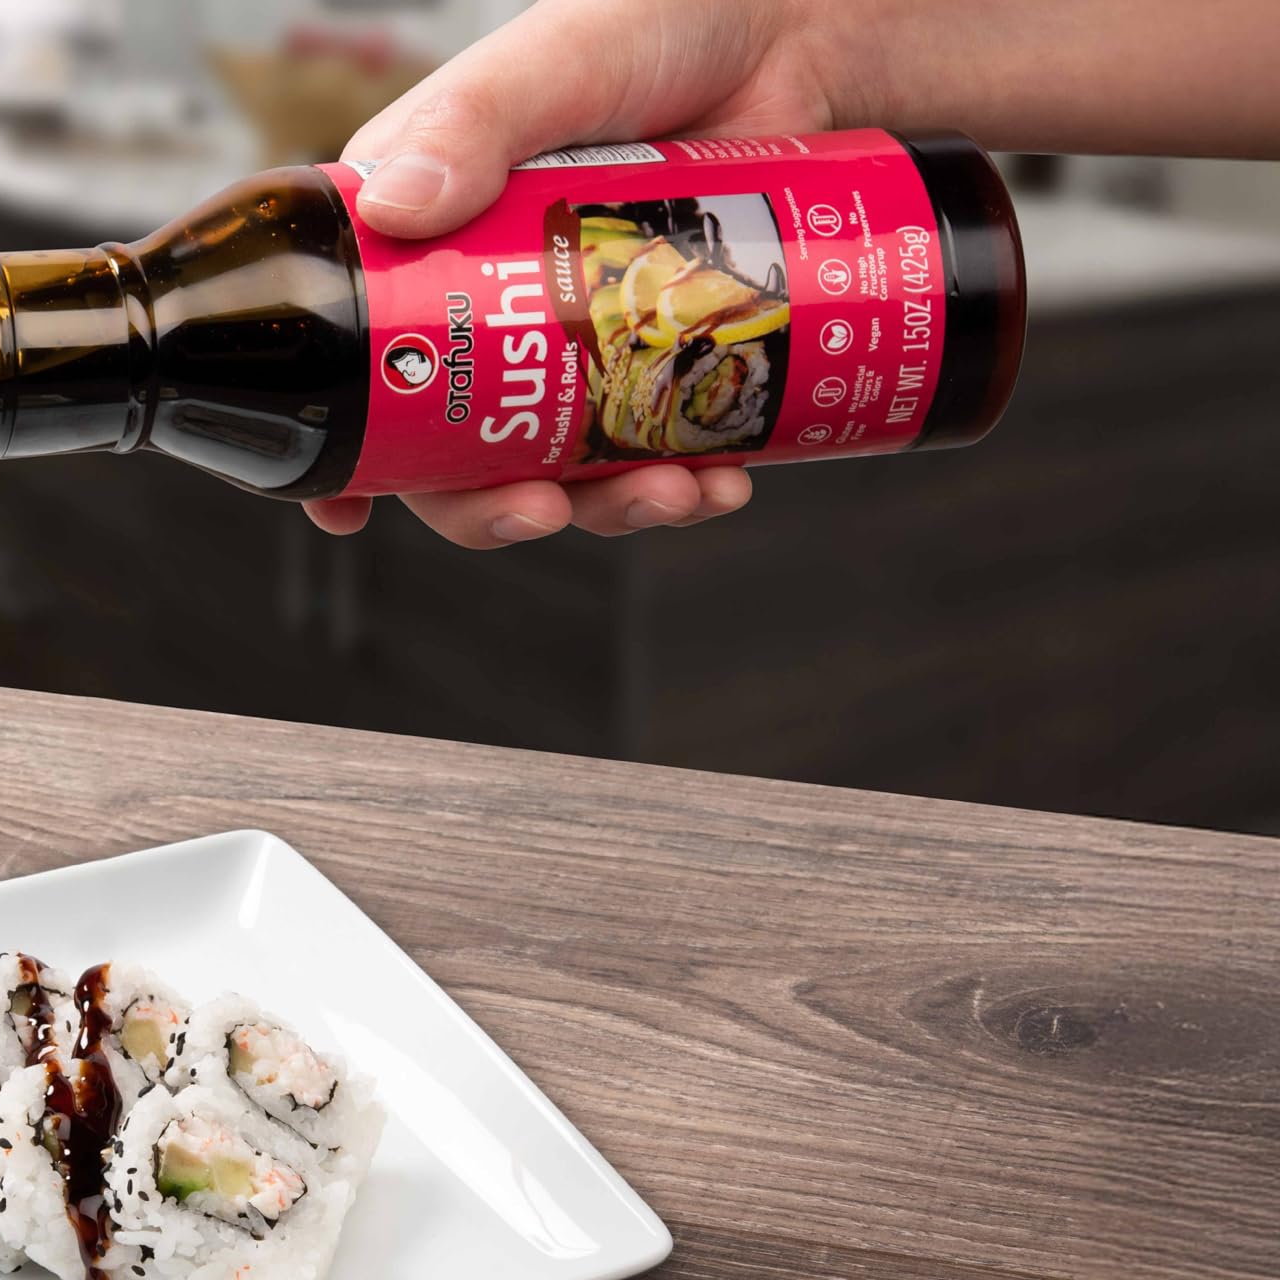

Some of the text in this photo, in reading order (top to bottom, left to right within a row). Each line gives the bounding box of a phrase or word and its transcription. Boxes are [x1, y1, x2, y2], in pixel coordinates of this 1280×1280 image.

[784, 187, 808, 260] Serving Suggestion
[849, 212, 858, 224] No
[852, 190, 873, 248] Preservatives
[553, 234, 577, 304] sauce
[858, 256, 869, 294] No High
[868, 254, 878, 296] Fructose
[877, 248, 888, 301] Corn Syrup
[895, 226, 933, 293] (425g)
[480, 259, 549, 443] Sushi
[868, 317, 881, 352] Vegan
[859, 379, 874, 408] Flavors
[870, 375, 883, 401] Colors
[896, 360, 928, 391] WT.
[542, 341, 578, 465] For Sushi & Rolls
[885, 395, 919, 423] NET
